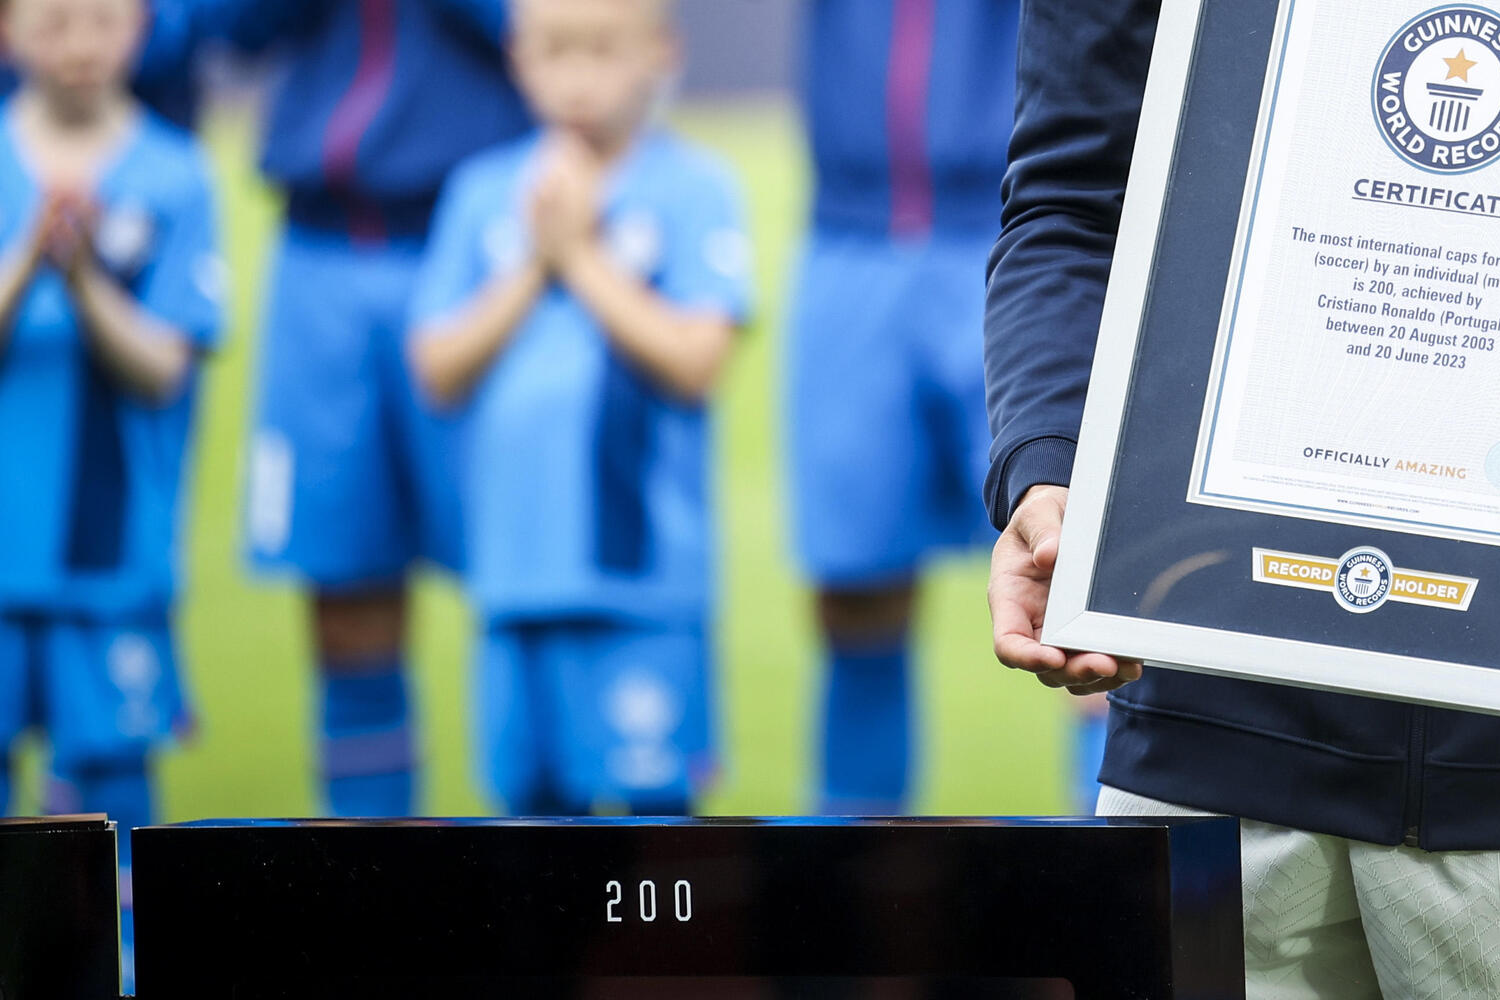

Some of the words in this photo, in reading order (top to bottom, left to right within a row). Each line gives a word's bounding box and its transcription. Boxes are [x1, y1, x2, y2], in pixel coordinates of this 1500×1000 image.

[1380, 71, 1425, 155] WORLD
[1292, 226, 1316, 243] The
[1319, 234, 1353, 248] most
[1356, 235, 1443, 259] international
[1446, 250, 1478, 266] caps
[1314, 251, 1369, 273] (soccer)
[1373, 258, 1390, 277] by
[1393, 264, 1410, 276] an
[1413, 263, 1479, 285] individual
[1317, 294, 1377, 315] Cristiano
[1381, 302, 1436, 323] Ronaldo
[1352, 277, 1365, 292] is
[1368, 279, 1396, 298] 200,
[1401, 286, 1463, 305] achieved
[1466, 292, 1483, 310] by
[1325, 316, 1385, 337] between
[1388, 325, 1406, 340] 20
[1409, 327, 1458, 347] August
[1461, 334, 1495, 352] 2003
[1346, 343, 1372, 357] and
[1374, 344, 1392, 360] 20
[1395, 347, 1429, 365] June
[1432, 352, 1467, 369] 2023
[1303, 446, 1390, 469] OFFICIALLY
[1394, 459, 1467, 480] AMAZING
[1267, 560, 1333, 582] RECORD
[1393, 578, 1459, 600] HOLDER
[1346, 553, 1386, 573] GUINNESS
[1338, 572, 1356, 604] WORLD
[1355, 578, 1389, 607] RECORDS
[606, 879, 692, 922] 200
